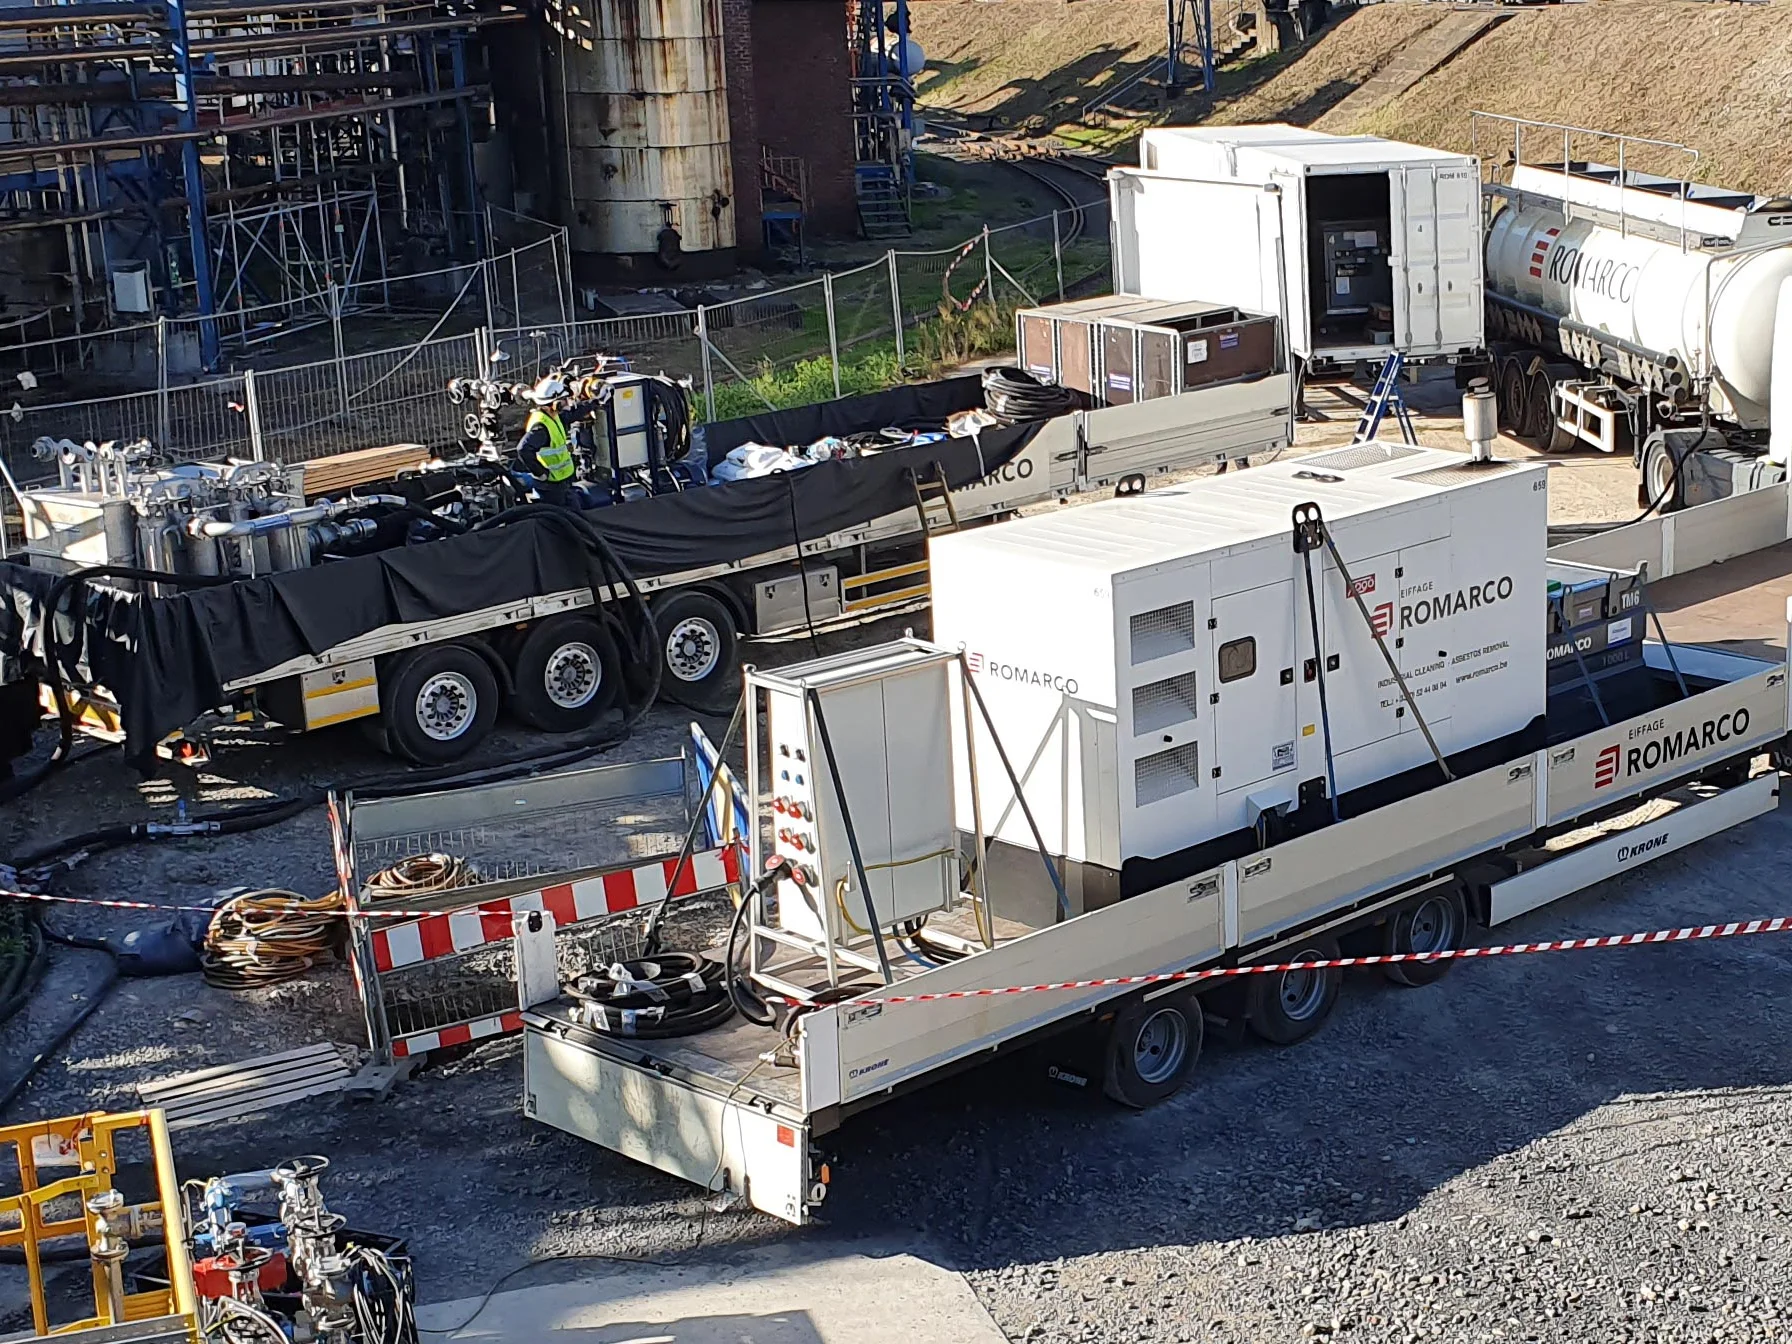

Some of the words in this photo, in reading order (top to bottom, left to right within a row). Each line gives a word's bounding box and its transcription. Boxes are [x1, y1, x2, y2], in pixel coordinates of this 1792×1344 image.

[1401, 581, 1434, 598] EIFFAGE
[1401, 576, 1513, 630] ROMARCO
[990, 662, 1078, 694] ROMARCO
[1627, 708, 1750, 776] ROMARCO
[1628, 719, 1665, 740] EIFFAGE
[1630, 833, 1670, 858] KRONE
